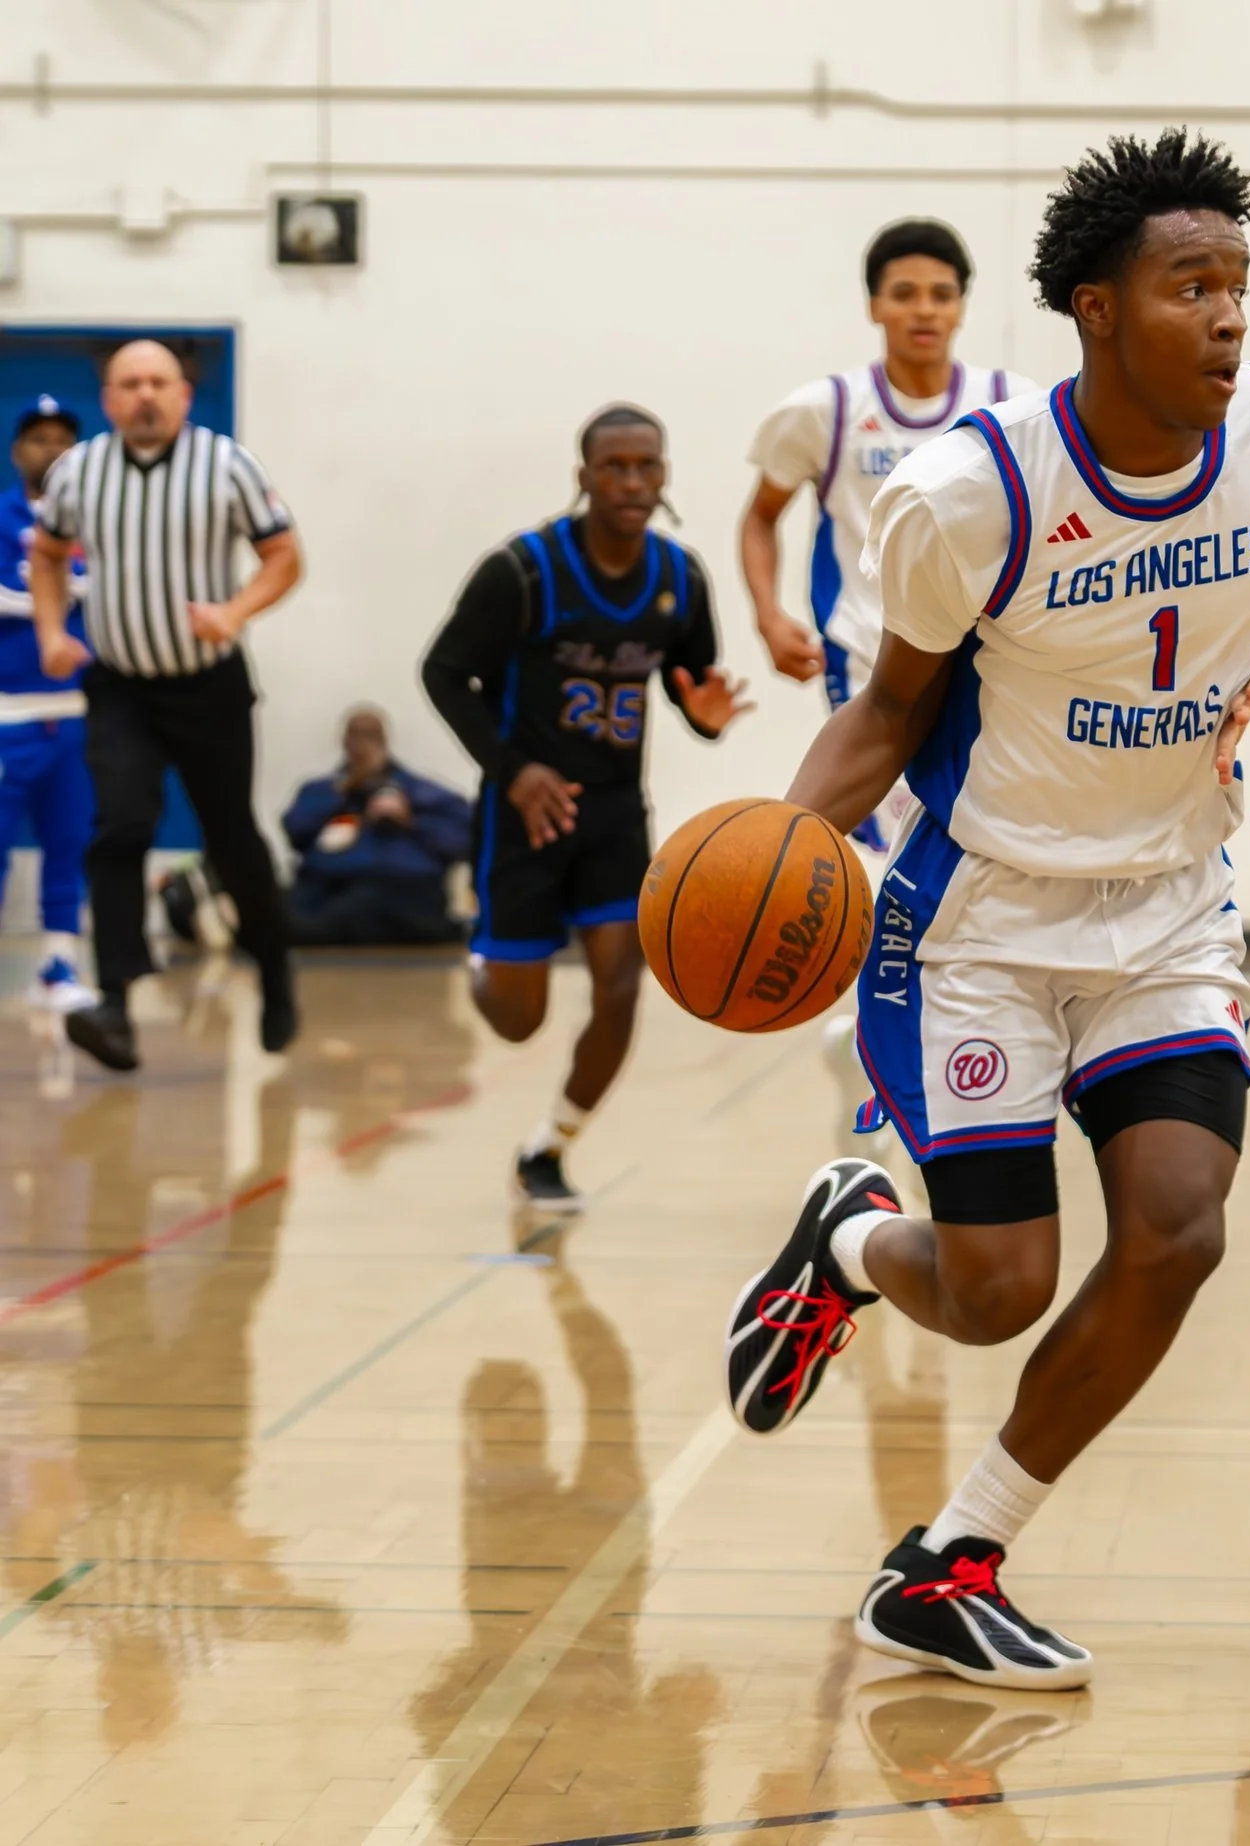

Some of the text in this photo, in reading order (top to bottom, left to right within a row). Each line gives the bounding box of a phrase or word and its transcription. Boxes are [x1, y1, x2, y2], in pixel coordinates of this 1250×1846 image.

[1046, 558, 1117, 609] LOS
[1148, 605, 1180, 692] 1
[558, 676, 648, 746] 25
[1066, 684, 1224, 750] GENERALS
[747, 855, 836, 1005] Wilson
[873, 867, 918, 1007] LGACY
